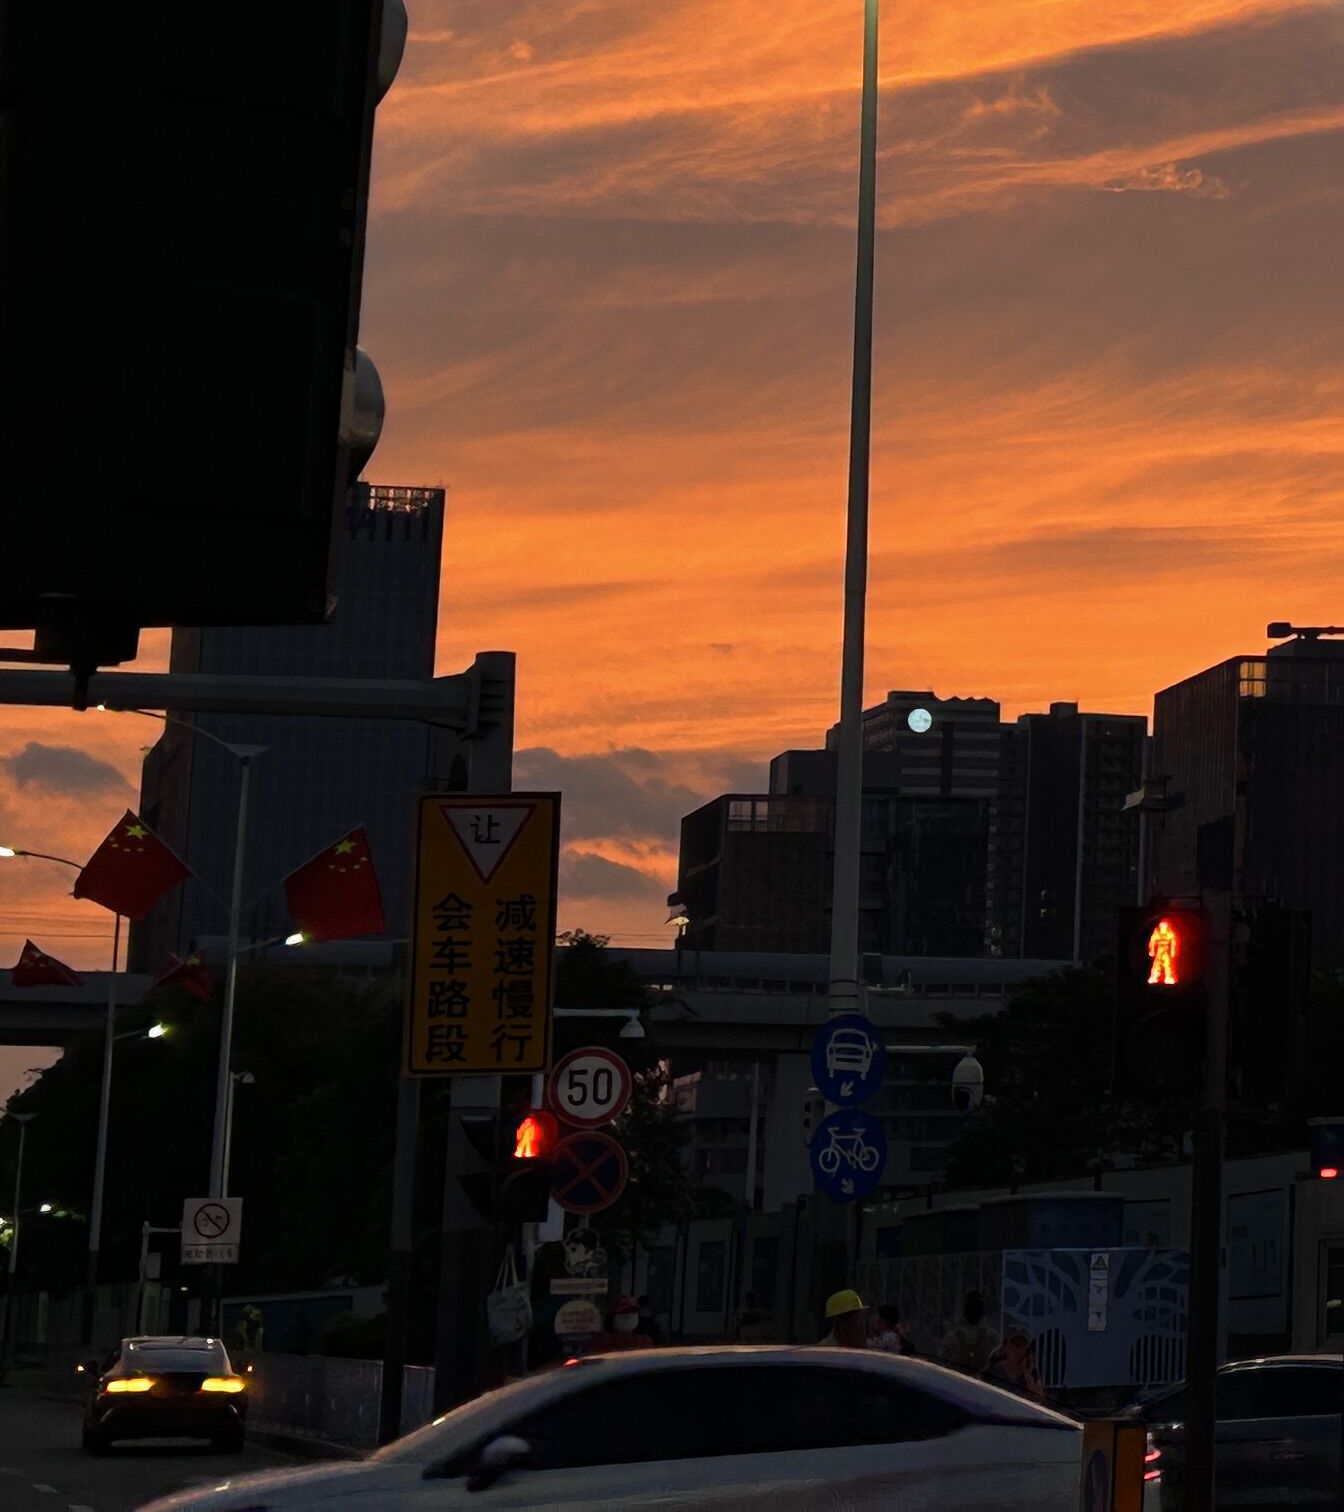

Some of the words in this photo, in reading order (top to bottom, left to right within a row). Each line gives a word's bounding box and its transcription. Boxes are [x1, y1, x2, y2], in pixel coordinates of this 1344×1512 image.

[470, 814, 500, 844] 让
[426, 892, 474, 1064] 会车路段
[490, 894, 537, 1063] 减速慢行
[567, 1068, 613, 1106] 50
